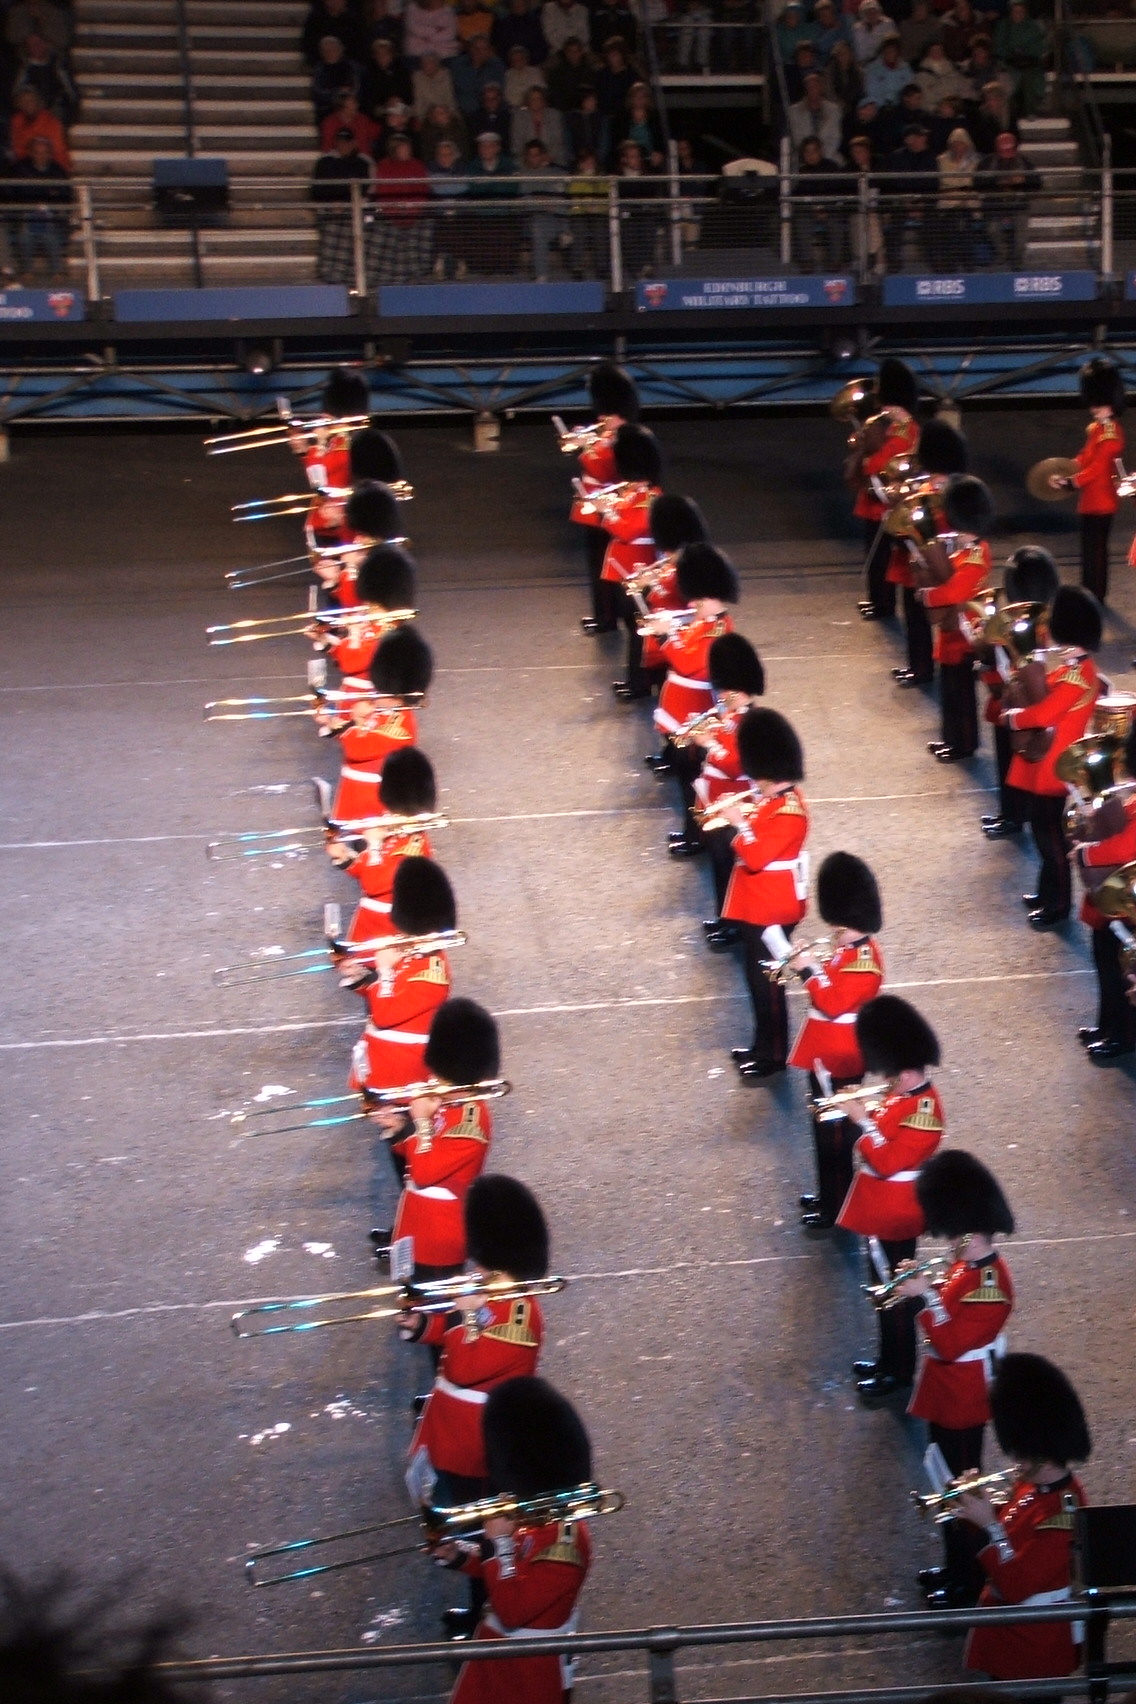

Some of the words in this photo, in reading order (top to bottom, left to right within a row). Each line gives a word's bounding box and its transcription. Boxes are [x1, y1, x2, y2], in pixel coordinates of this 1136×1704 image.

[703, 281, 787, 293] EDINBURGH
[931, 279, 965, 295] RBS
[1031, 276, 1063, 292] RBS
[682, 294, 750, 307] MILITARY
[753, 293, 810, 305] TATTOO
